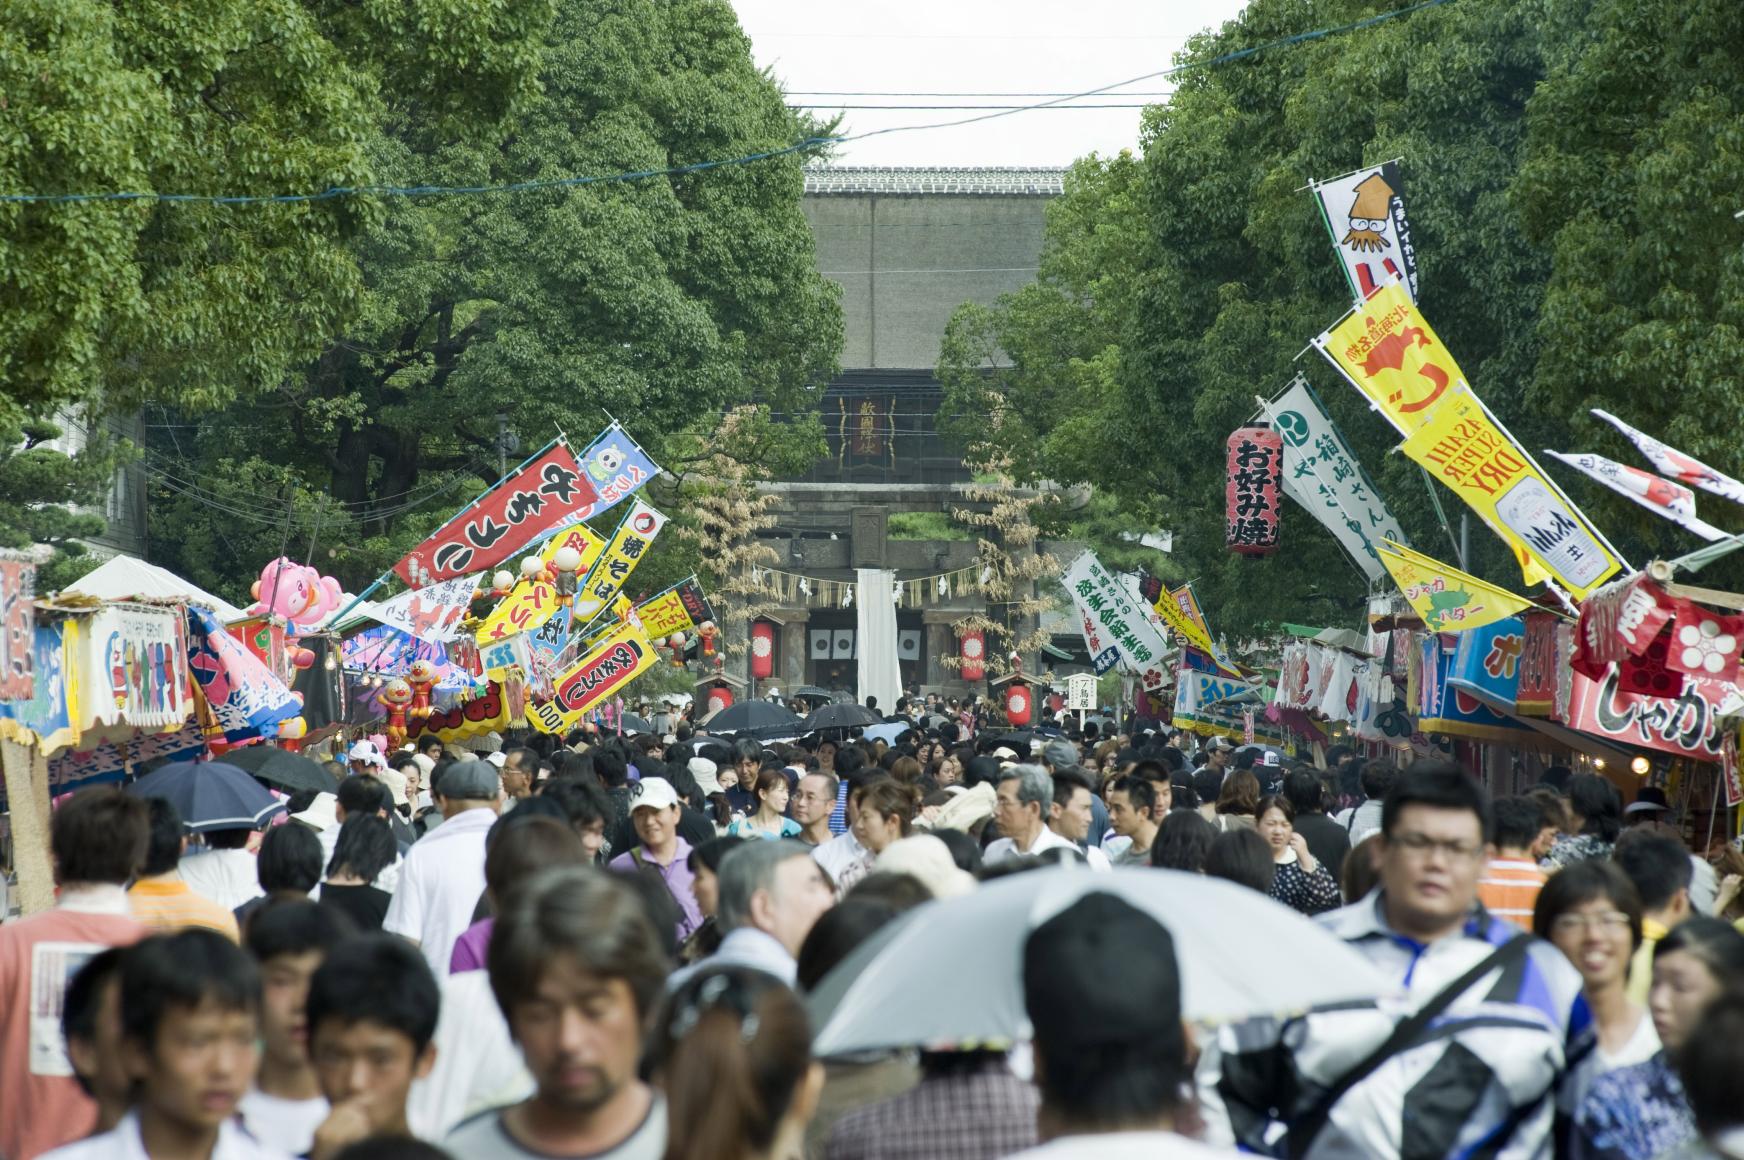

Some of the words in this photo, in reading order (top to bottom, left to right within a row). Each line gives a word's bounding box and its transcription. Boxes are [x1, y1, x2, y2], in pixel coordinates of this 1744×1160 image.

[1232, 440, 1272, 546] お好み焼
[593, 534, 645, 600] 焼そば
[639, 596, 679, 622] スーパー
[657, 610, 688, 631] アサヒ
